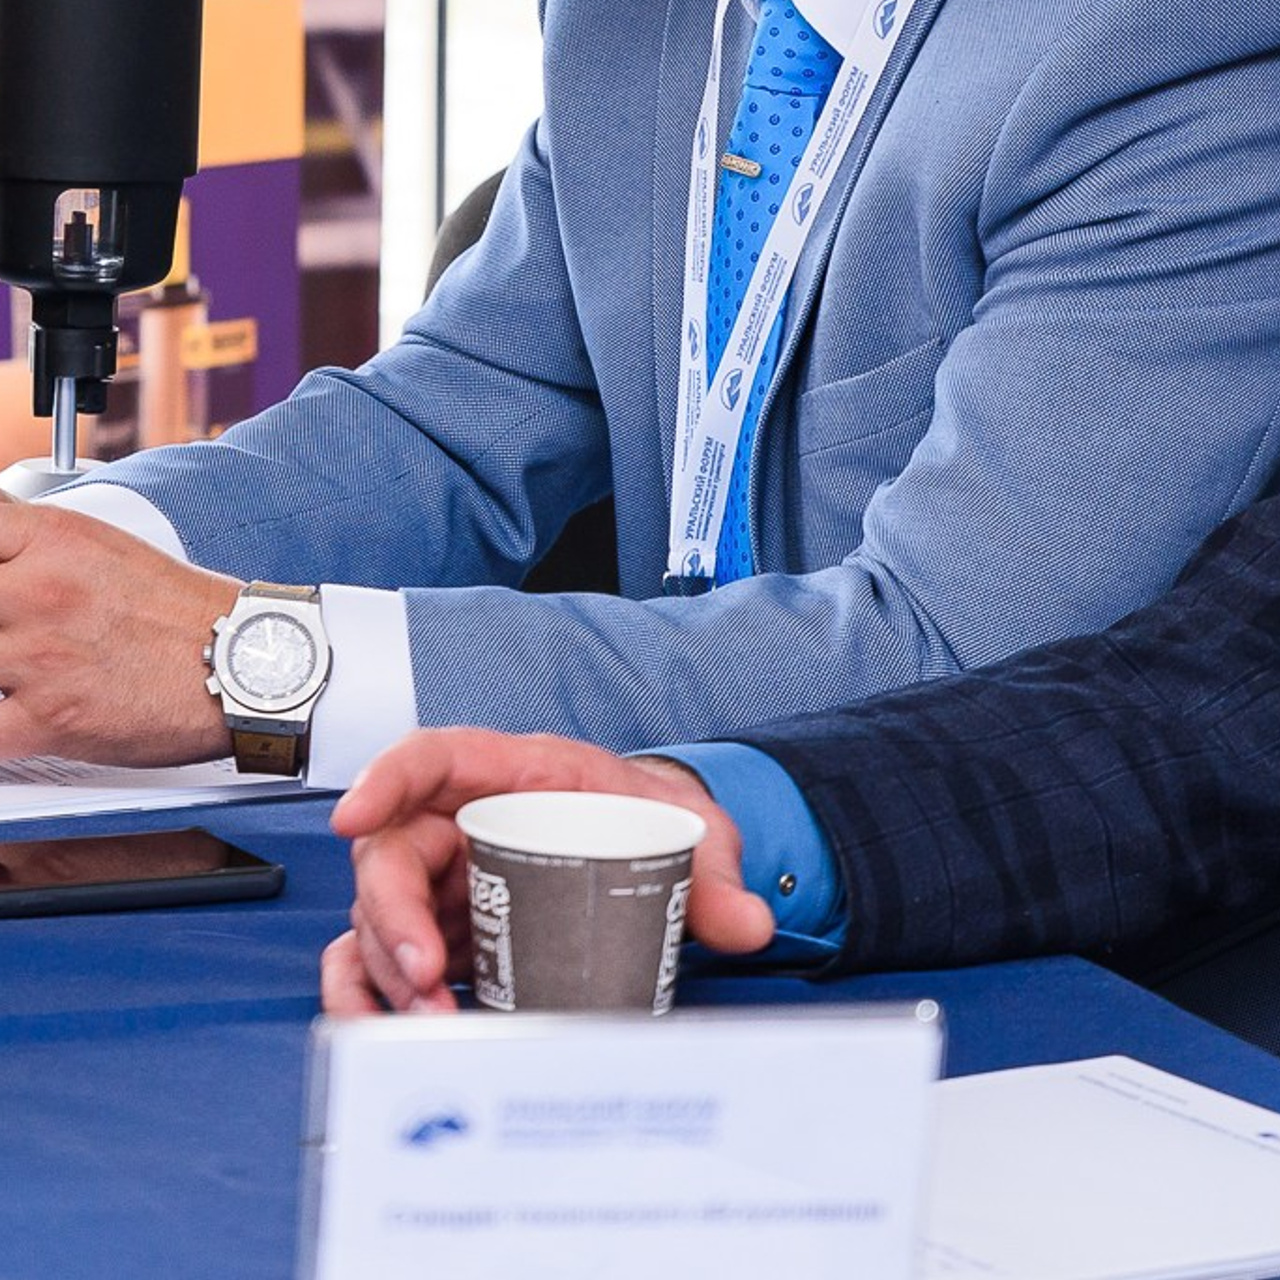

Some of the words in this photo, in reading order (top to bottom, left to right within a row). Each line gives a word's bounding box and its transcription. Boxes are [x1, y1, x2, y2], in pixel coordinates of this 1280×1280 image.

[809, 107, 841, 173] УРАЛЬСКИЙ
[838, 66, 859, 107] ФОРУМ
[736, 292, 763, 360] УРАЛЬСКИЙ
[760, 251, 779, 293] ФОРУМ
[685, 473, 706, 540] УРАЛЬСКИЙ
[700, 436, 714, 473] ФОРУМ
